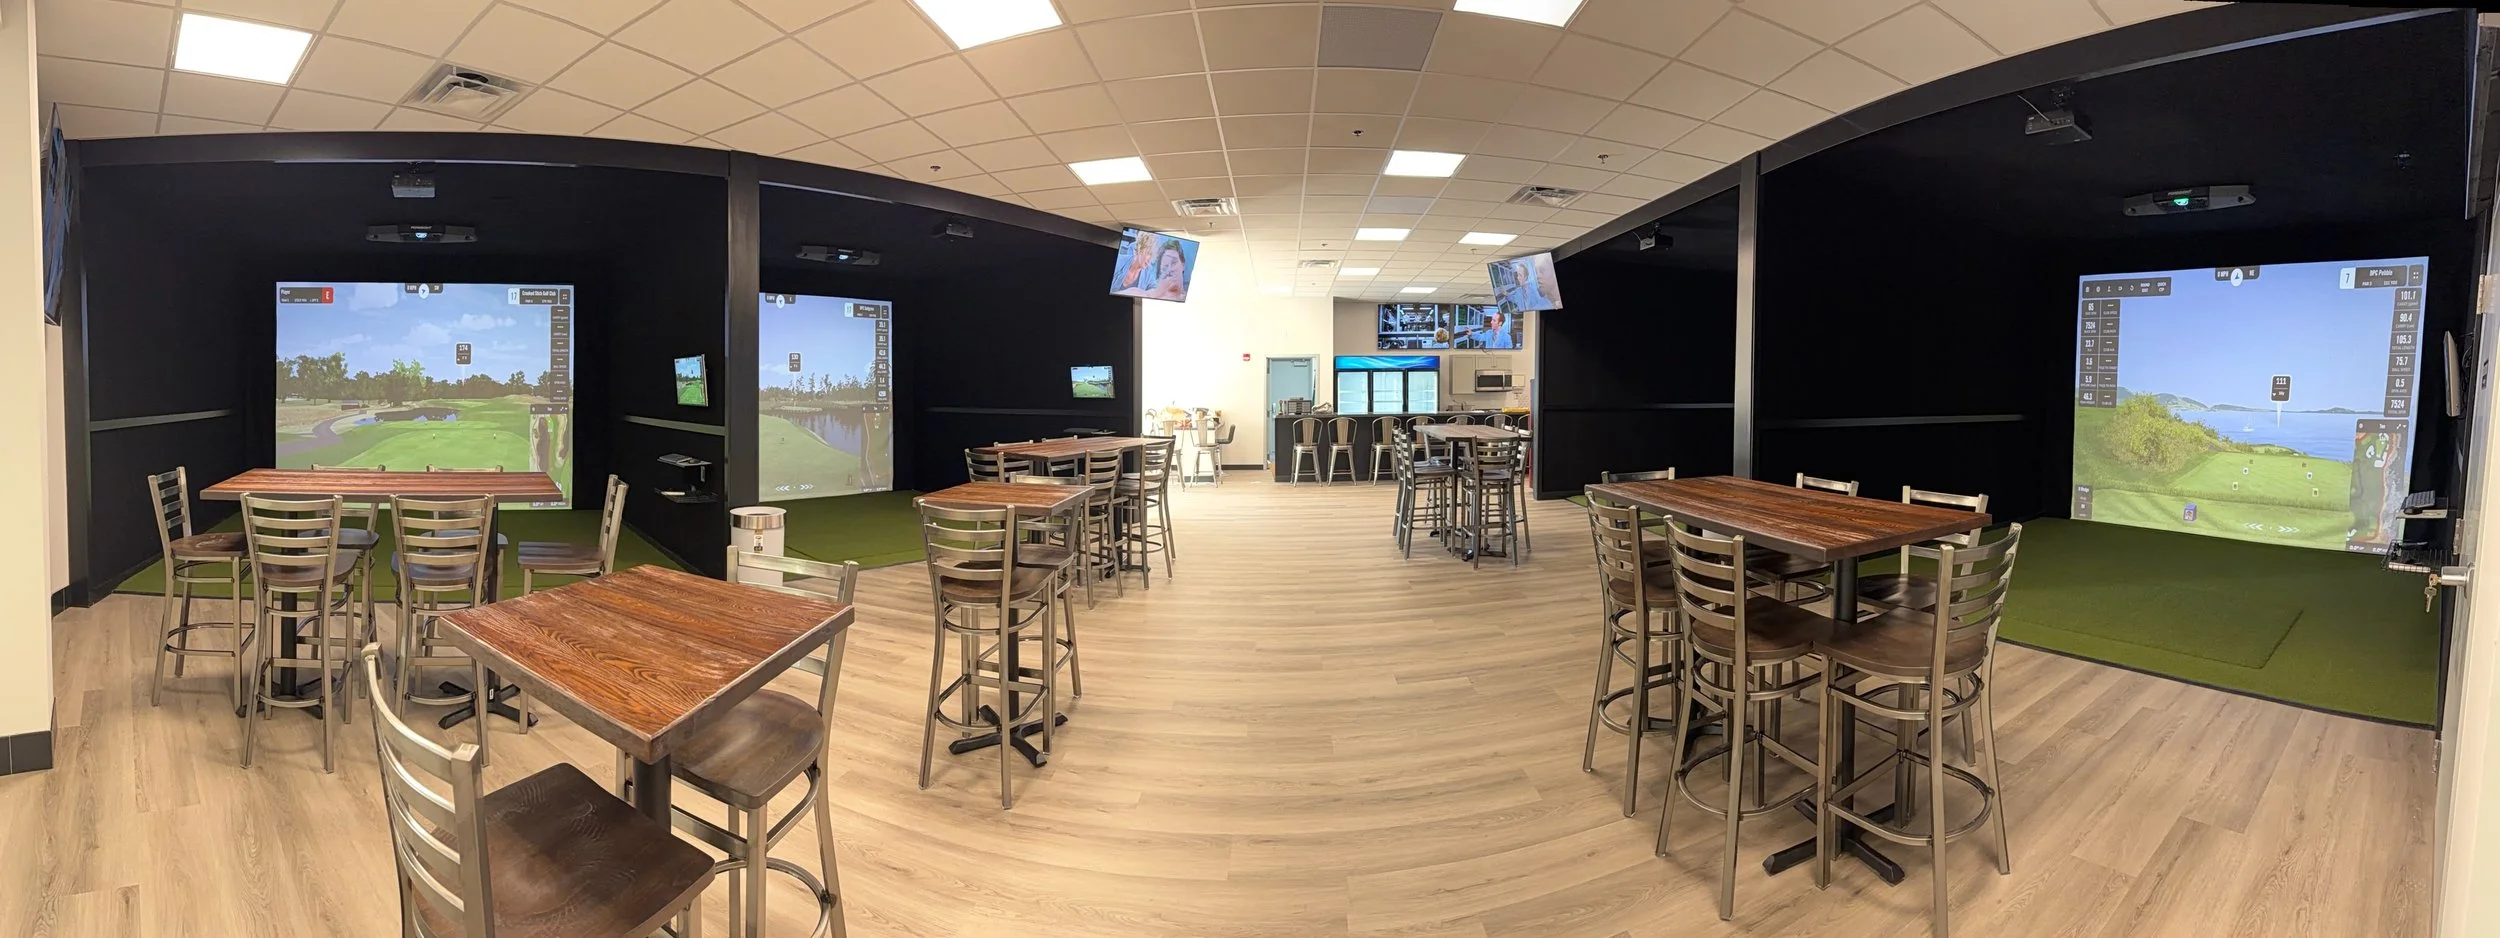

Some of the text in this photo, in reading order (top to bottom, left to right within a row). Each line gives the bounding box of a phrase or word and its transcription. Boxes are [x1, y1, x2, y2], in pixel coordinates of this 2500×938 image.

[2345, 273, 2350, 284] 7
[325, 291, 330, 300] E
[2401, 290, 2417, 300] 101.1
[2399, 313, 2413, 322] 90.4
[2085, 321, 2096, 330] 7524
[2396, 334, 2412, 344] 105.3
[2395, 356, 2409, 366] 75.7
[2276, 377, 2287, 385] 111
[2395, 378, 2405, 388] 0.5
[2390, 399, 2405, 409] 7524
